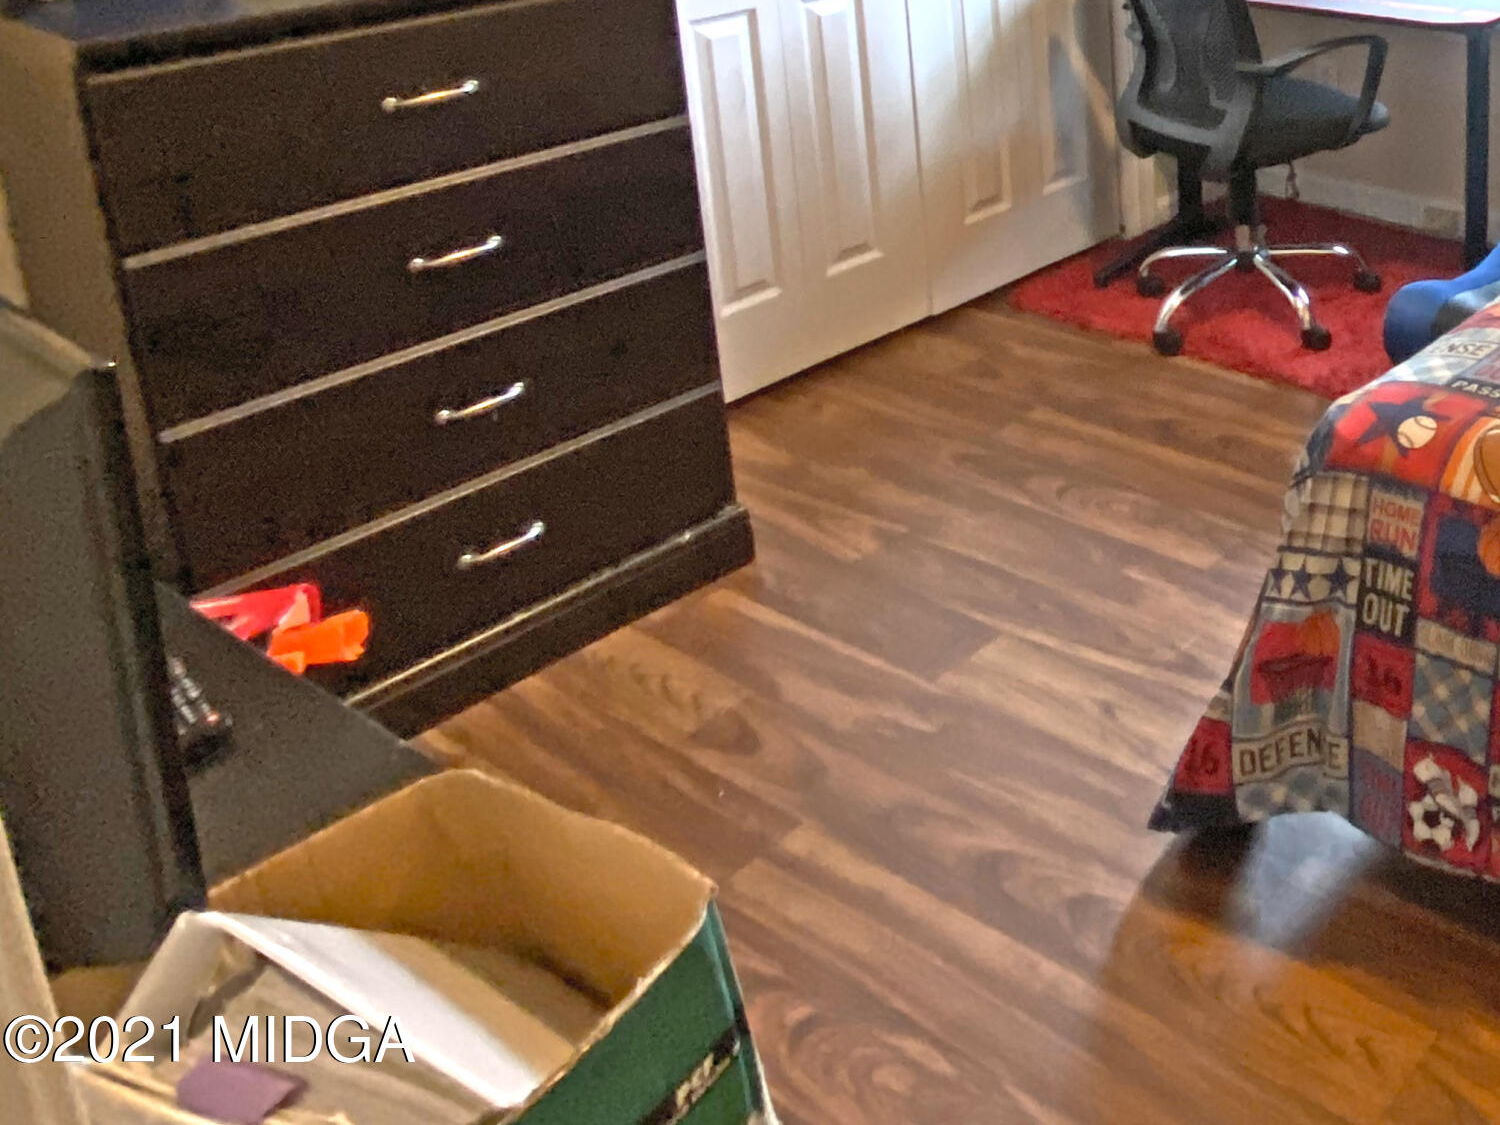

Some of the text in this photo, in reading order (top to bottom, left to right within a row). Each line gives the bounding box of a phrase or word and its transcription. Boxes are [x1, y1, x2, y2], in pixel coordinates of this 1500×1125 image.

[1373, 496, 1422, 524] HOME
[1368, 520, 1417, 551] RUN
[1364, 558, 1415, 601] TIME
[1362, 593, 1411, 637] OUT
[1239, 729, 1342, 777] DEFENE
